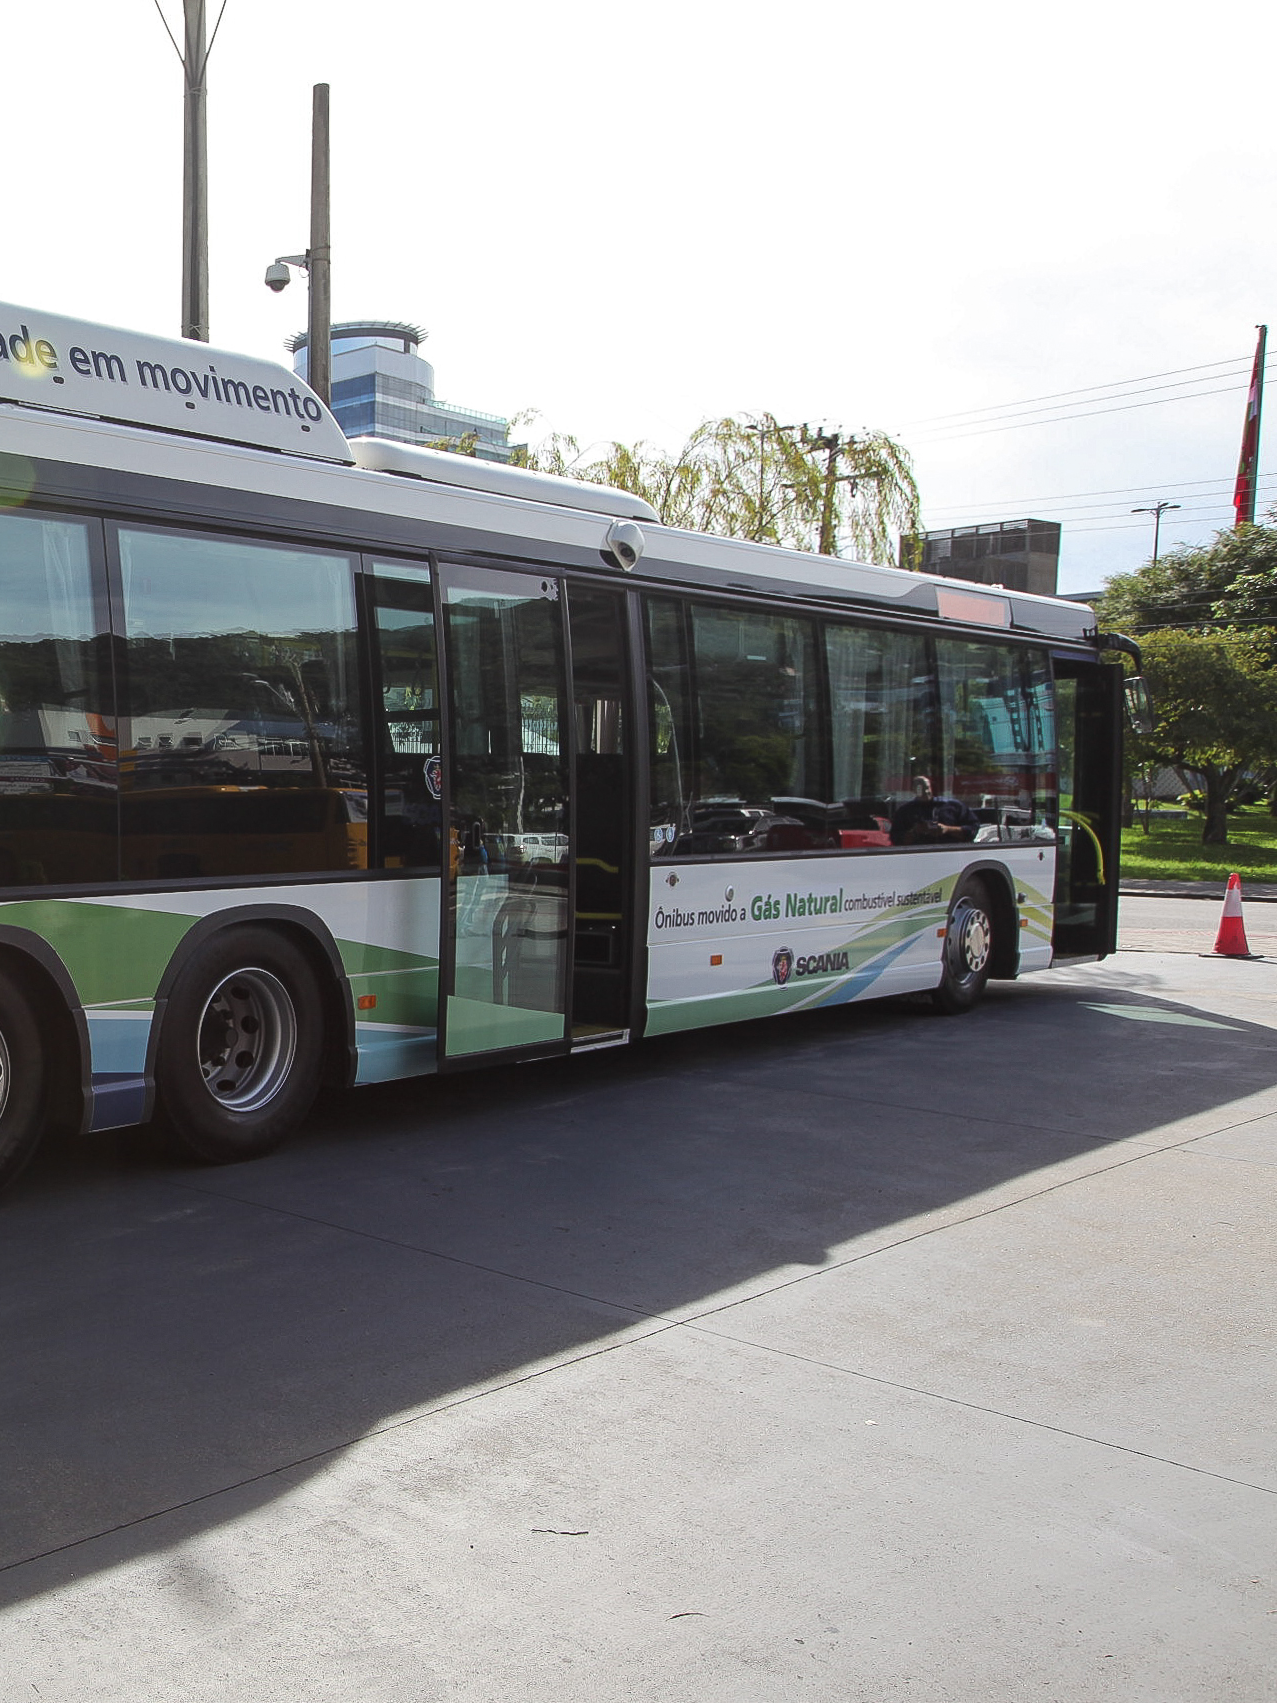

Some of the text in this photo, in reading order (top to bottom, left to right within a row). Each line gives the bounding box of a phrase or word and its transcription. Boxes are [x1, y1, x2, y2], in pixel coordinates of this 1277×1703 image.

[69, 351, 127, 384] em
[139, 361, 323, 423] movimento
[655, 887, 943, 929] Ônibus movido a Gás Natural combustível sustentável
[796, 952, 849, 977] SCANIA
